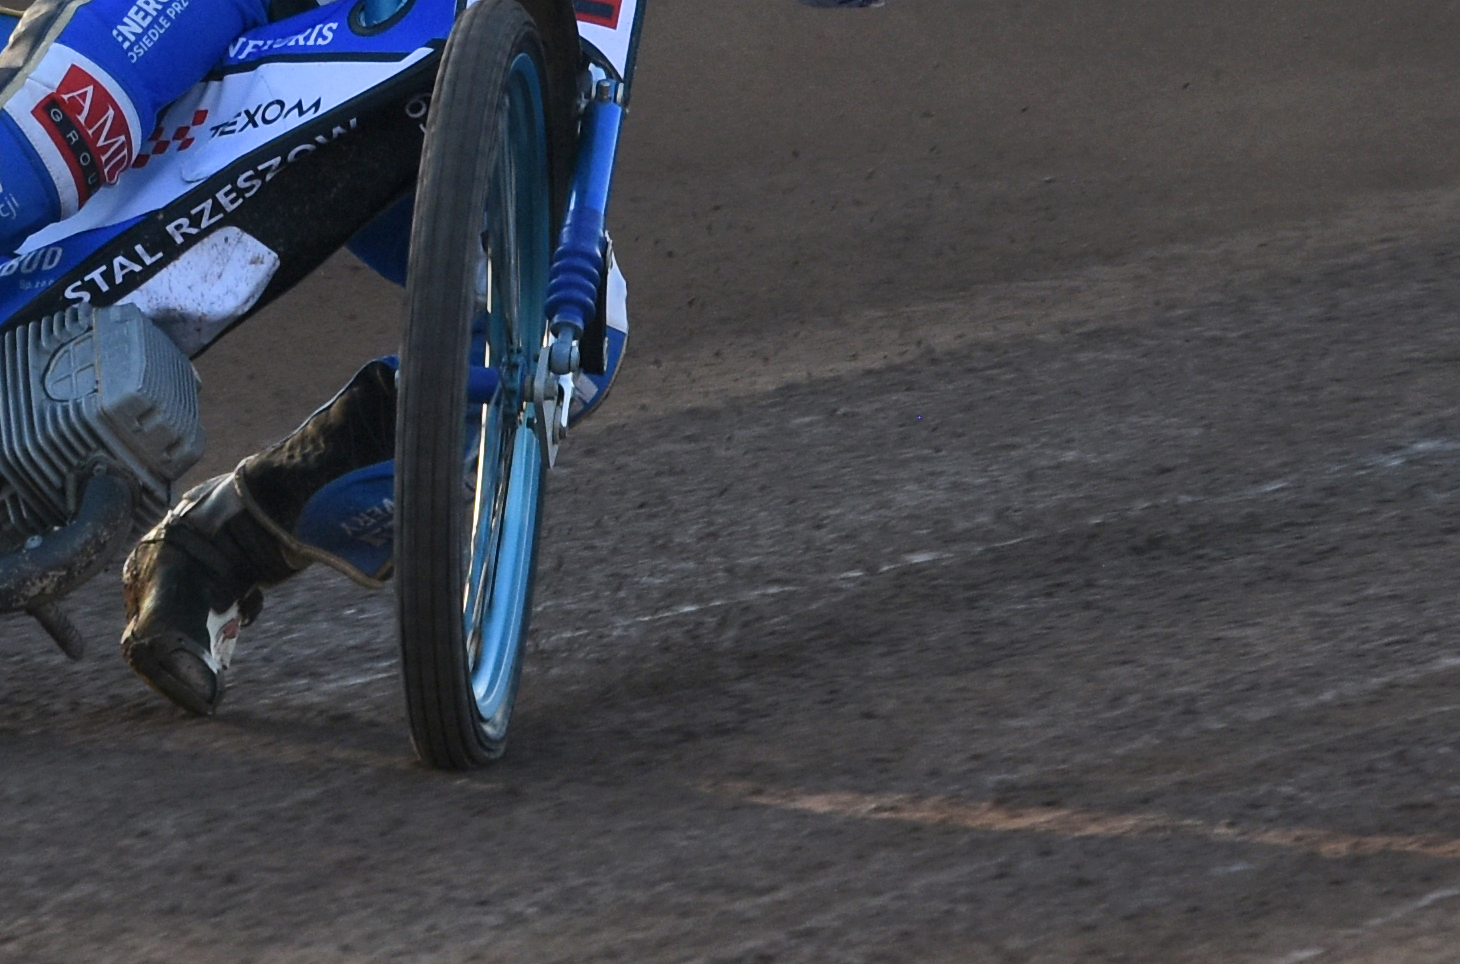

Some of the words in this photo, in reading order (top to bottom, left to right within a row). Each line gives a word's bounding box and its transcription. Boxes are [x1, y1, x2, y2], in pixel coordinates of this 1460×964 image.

[50, 107, 97, 185] GROU
[60, 84, 128, 184] AMD
[209, 96, 322, 139] TEXOM
[64, 243, 163, 307] STAL
